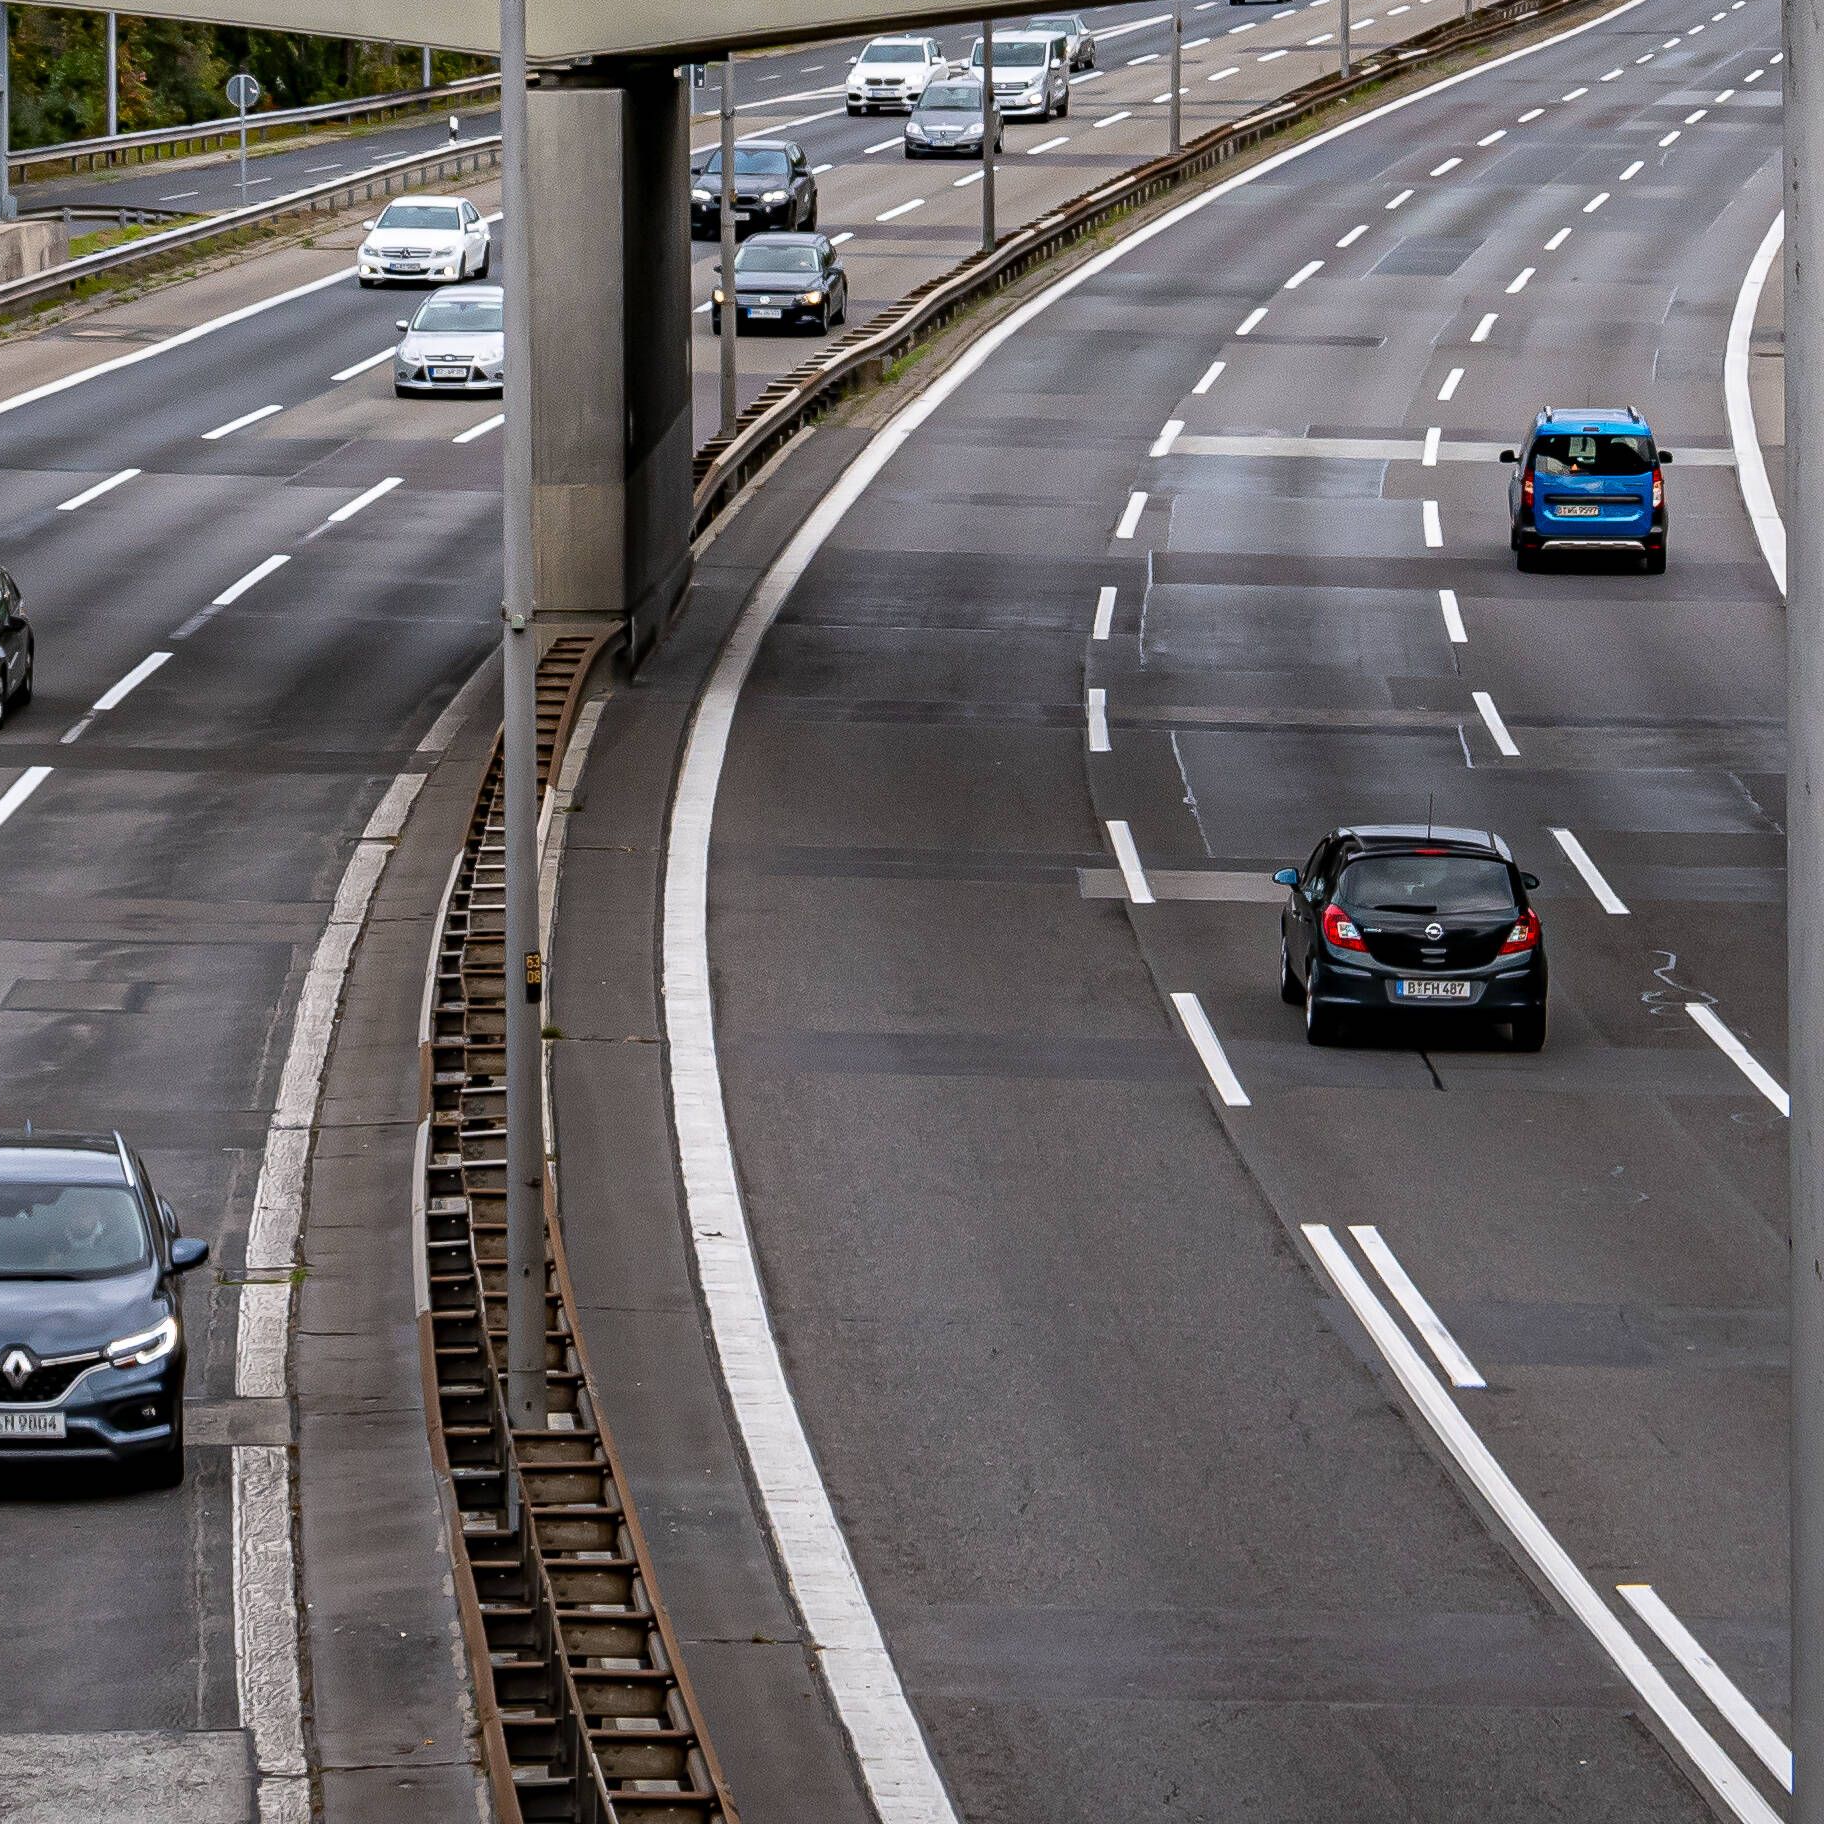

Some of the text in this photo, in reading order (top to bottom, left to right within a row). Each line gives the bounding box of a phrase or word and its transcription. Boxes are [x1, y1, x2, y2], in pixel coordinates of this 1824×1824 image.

[1408, 982, 1465, 994] B FH 487
